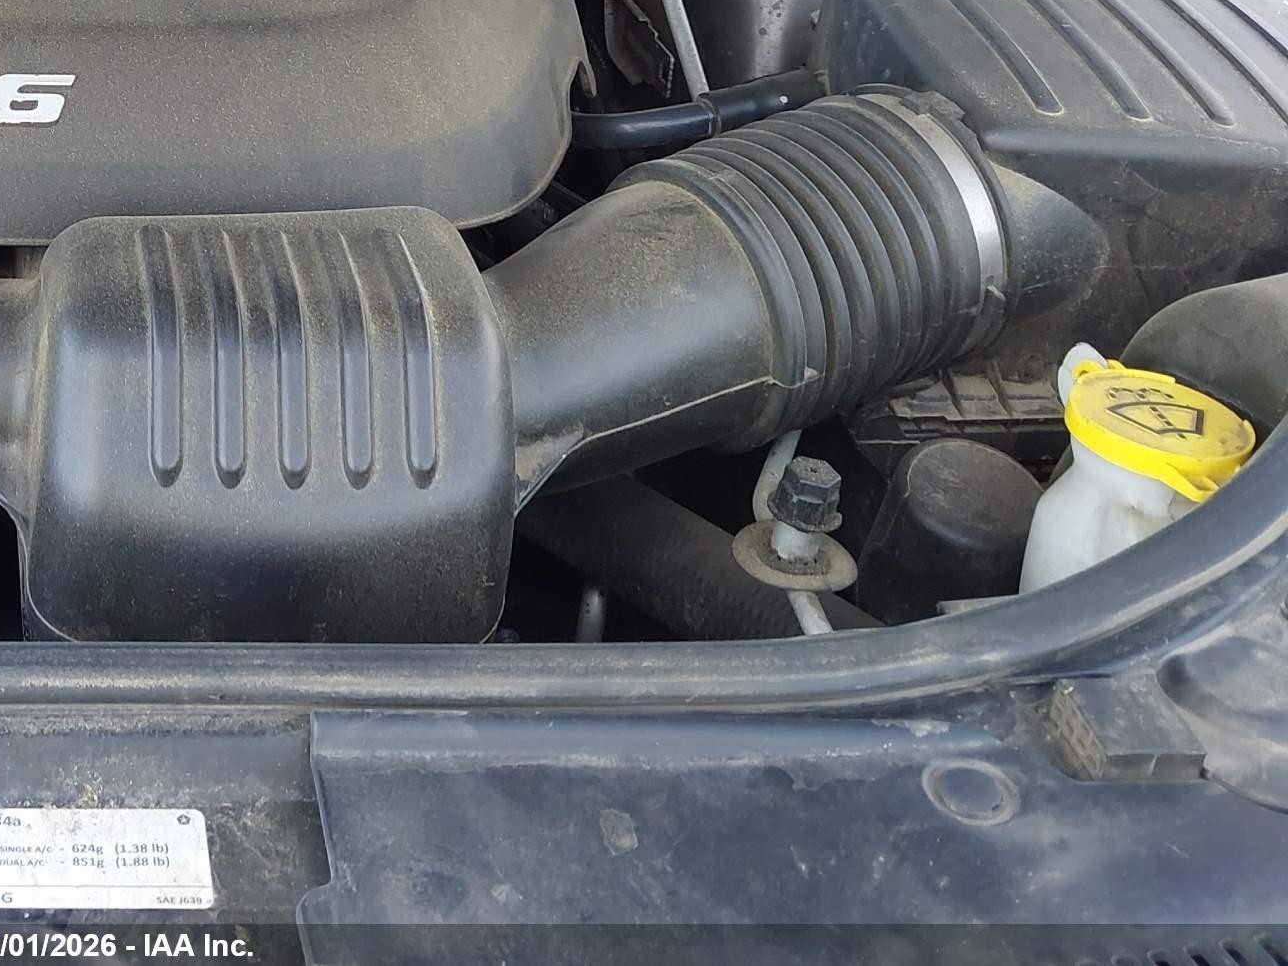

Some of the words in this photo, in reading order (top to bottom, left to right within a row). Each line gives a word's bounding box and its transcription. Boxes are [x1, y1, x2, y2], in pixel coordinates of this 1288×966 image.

[0, 845, 33, 854] SINGLE
[34, 845, 54, 855] A/C
[71, 843, 105, 856] 624g
[114, 843, 149, 855] (1.38
[151, 842, 170, 855] lb)
[0, 858, 27, 868] DUAL
[27, 858, 46, 869] A/C
[72, 857, 105, 869] 851g
[115, 857, 149, 868] (1.88
[152, 856, 171, 869] lb)
[156, 896, 176, 905] SAE
